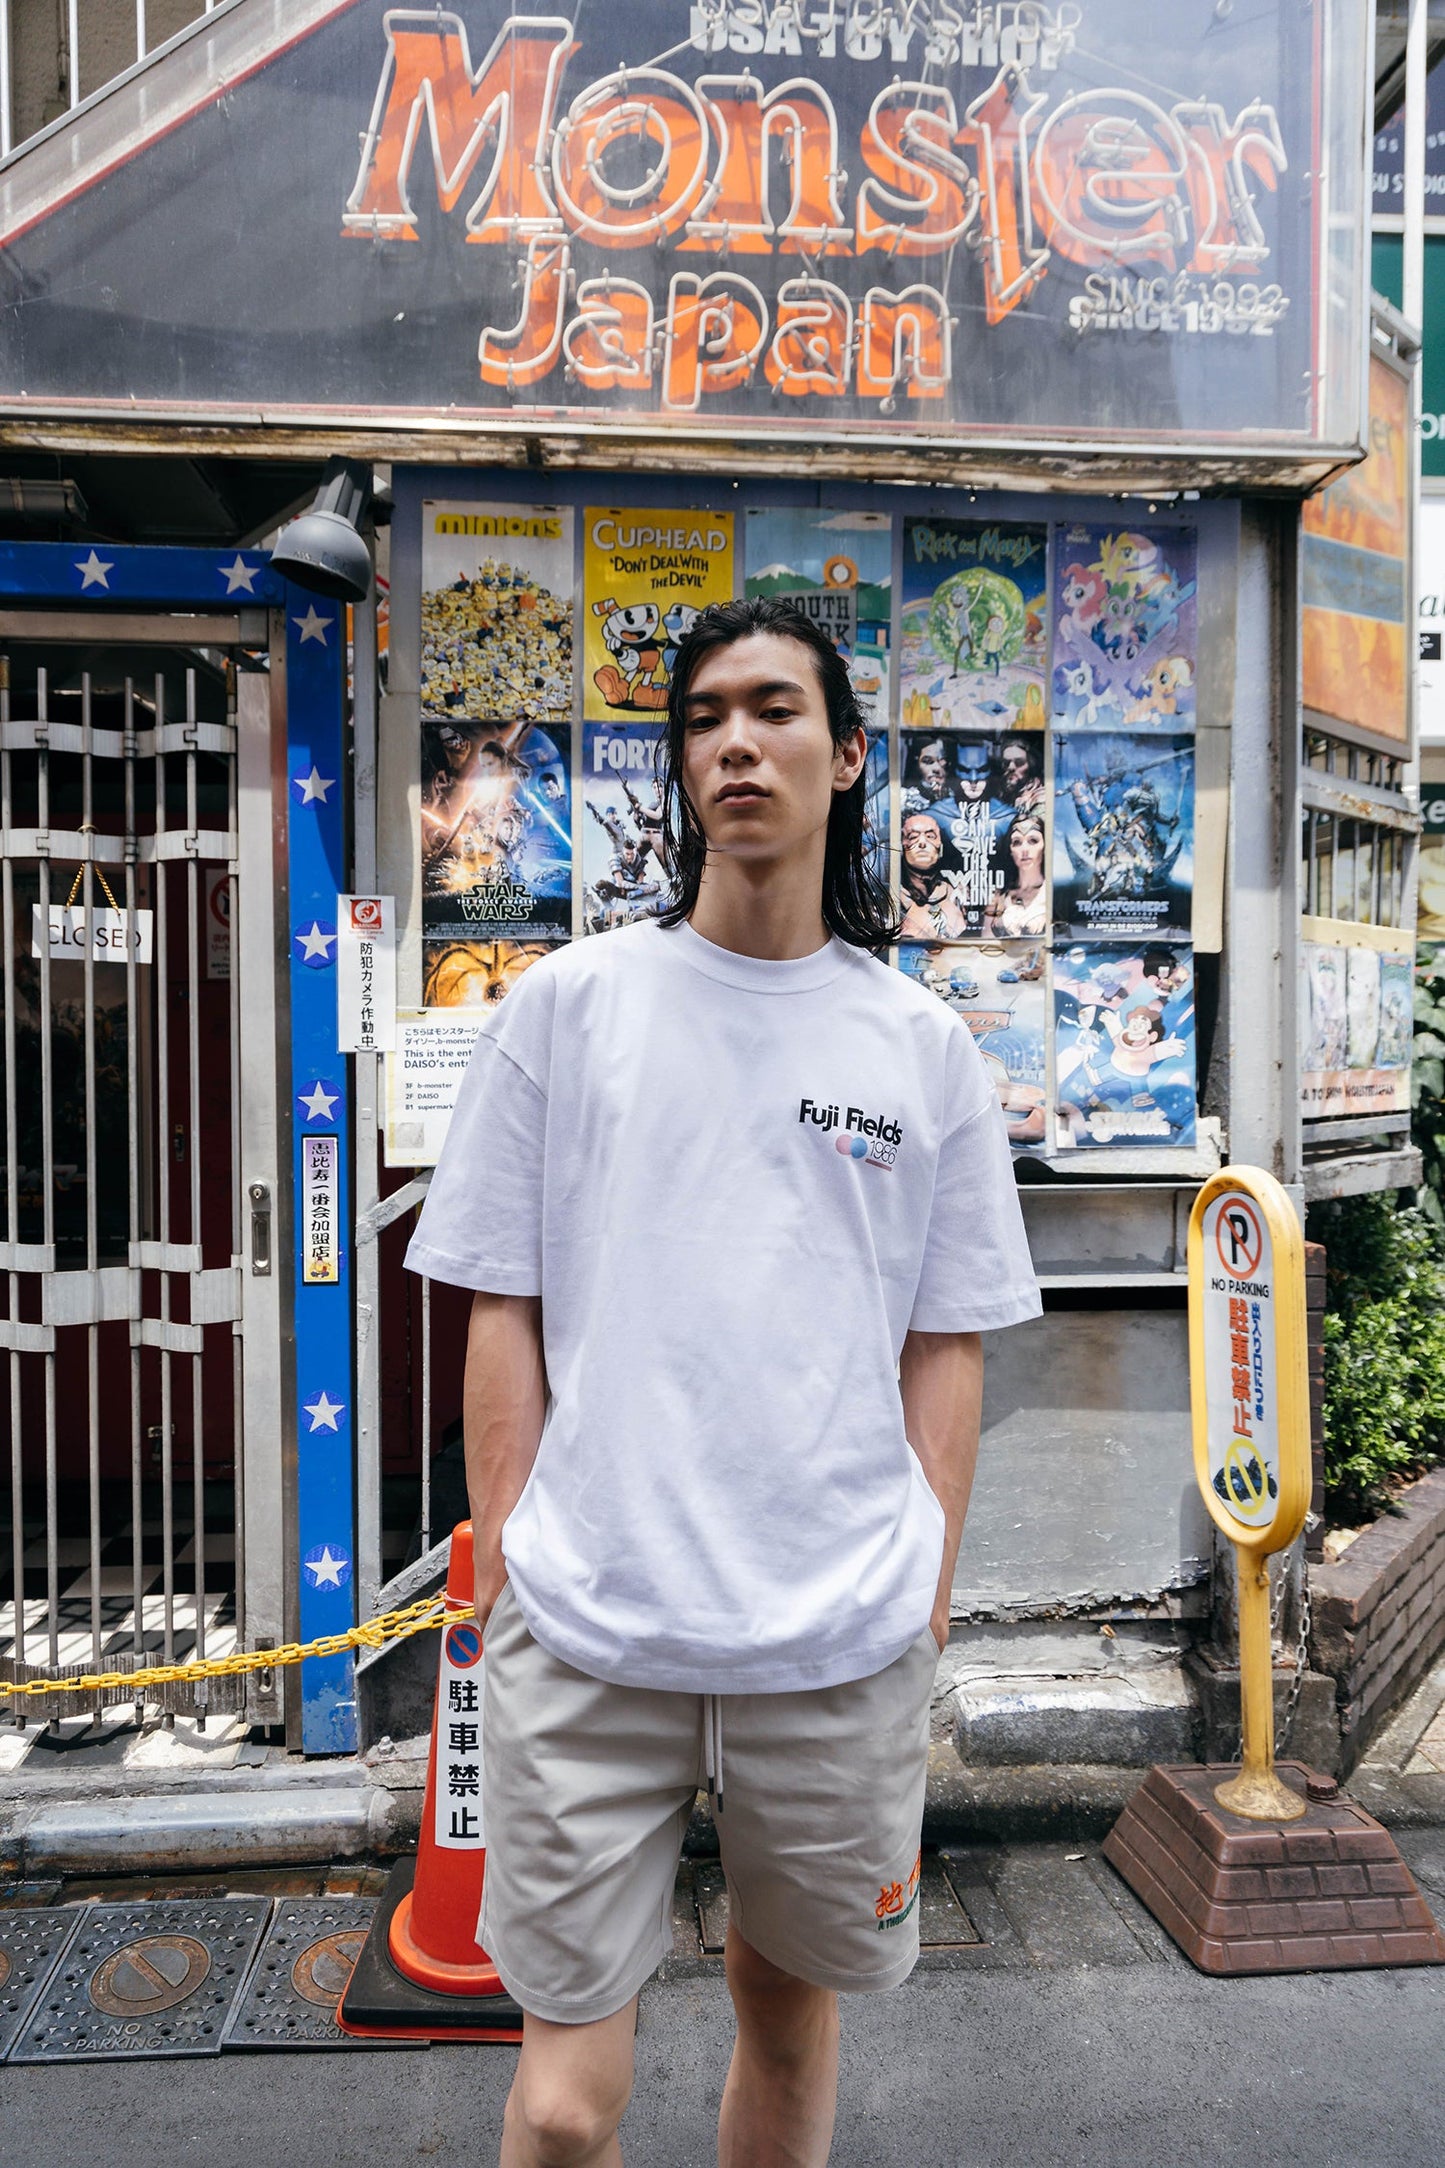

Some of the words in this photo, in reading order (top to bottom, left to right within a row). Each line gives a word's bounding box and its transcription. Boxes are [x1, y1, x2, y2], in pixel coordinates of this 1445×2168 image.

[690, 7, 802, 55] USA
[811, 12, 915, 62] TOY
[923, 18, 1078, 71] SHOP
[340, 9, 1288, 325] Monster
[477, 233, 954, 413] Japan
[461, 883, 533, 899] STAR
[461, 904, 533, 921] WARS
[360, 942, 374, 1047] 防犯カメラ作動中
[404, 1049, 424, 1058] This
[427, 1049, 435, 1058] is
[438, 1049, 454, 1057] the
[798, 1098, 840, 1132] Fuji
[845, 1106, 903, 1146] Fields
[870, 1140, 898, 1165] 1986
[1211, 1277, 1227, 1291] NO
[1228, 1279, 1270, 1298] PARKING
[1229, 1297, 1253, 1438] 駐車禁止
[448, 1679, 480, 1840] 駐車禁止
[73, 2036, 164, 2052] PARKING
[106, 2022, 142, 2036] NO
